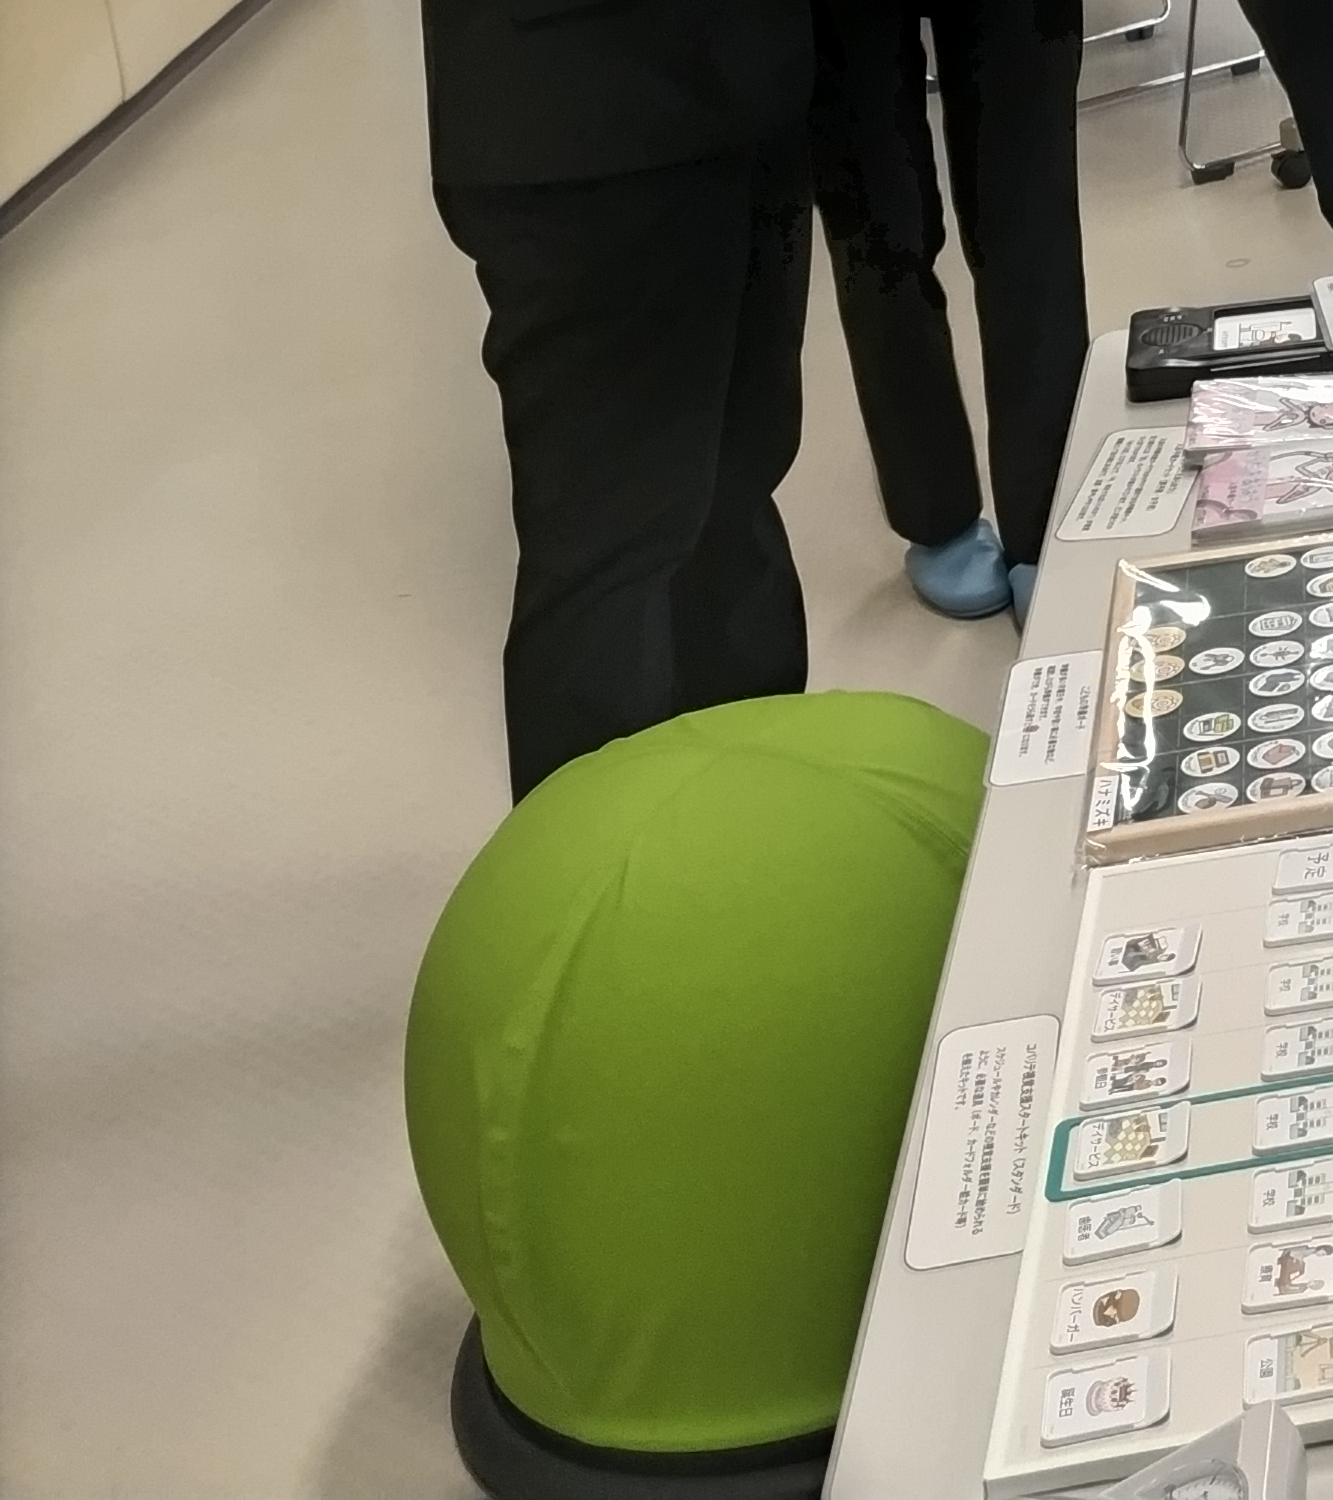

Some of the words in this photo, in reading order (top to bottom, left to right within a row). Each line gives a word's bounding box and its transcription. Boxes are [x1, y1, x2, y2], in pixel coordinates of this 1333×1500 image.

[1092, 780, 1111, 826] ハナミズキ
[1304, 852, 1329, 879] 予定
[1104, 991, 1121, 1033] デイサービス
[1275, 1041, 1289, 1058] 学校
[1265, 1114, 1279, 1131] 学校
[1087, 1123, 1105, 1169] デイサービス
[1262, 1189, 1276, 1207] 学校
[1077, 1216, 1091, 1241] 歯医者
[1066, 1288, 1084, 1342] ハンバーガー
[1259, 1357, 1274, 1378] 公園
[1058, 1387, 1076, 1418] 誕生日
